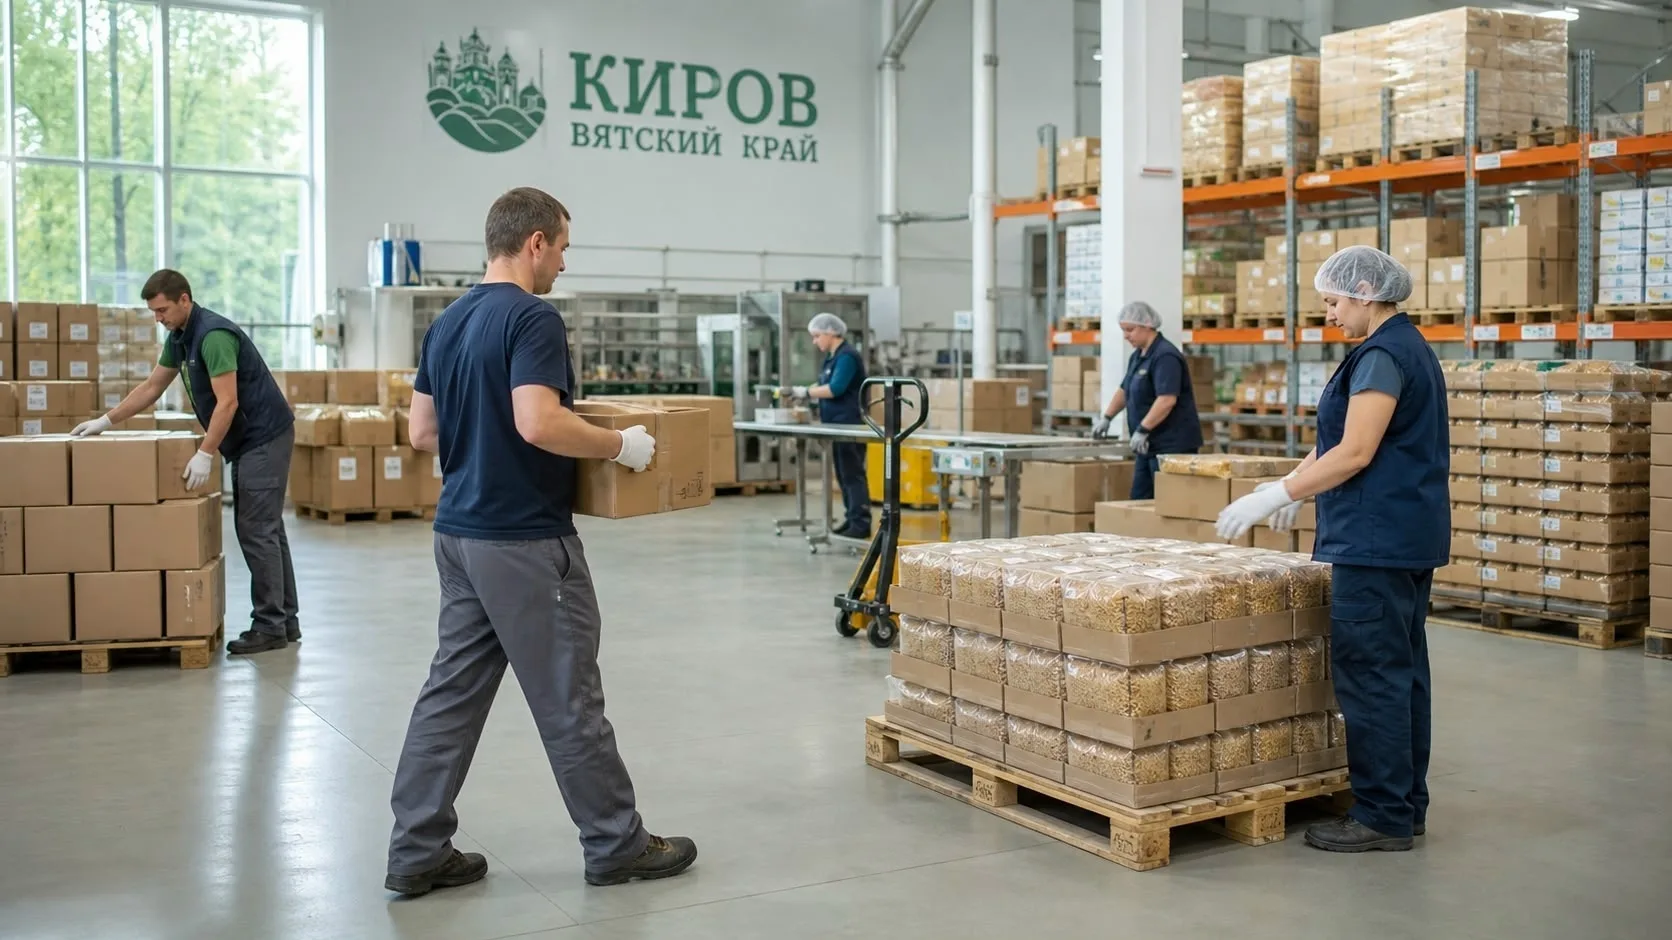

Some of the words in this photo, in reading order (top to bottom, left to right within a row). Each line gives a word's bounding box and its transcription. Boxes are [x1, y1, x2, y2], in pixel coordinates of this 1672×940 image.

[569, 51, 818, 128] КИРОВ
[570, 122, 722, 157] ВЯТСКИЙ
[742, 134, 819, 163] КРАЙ
